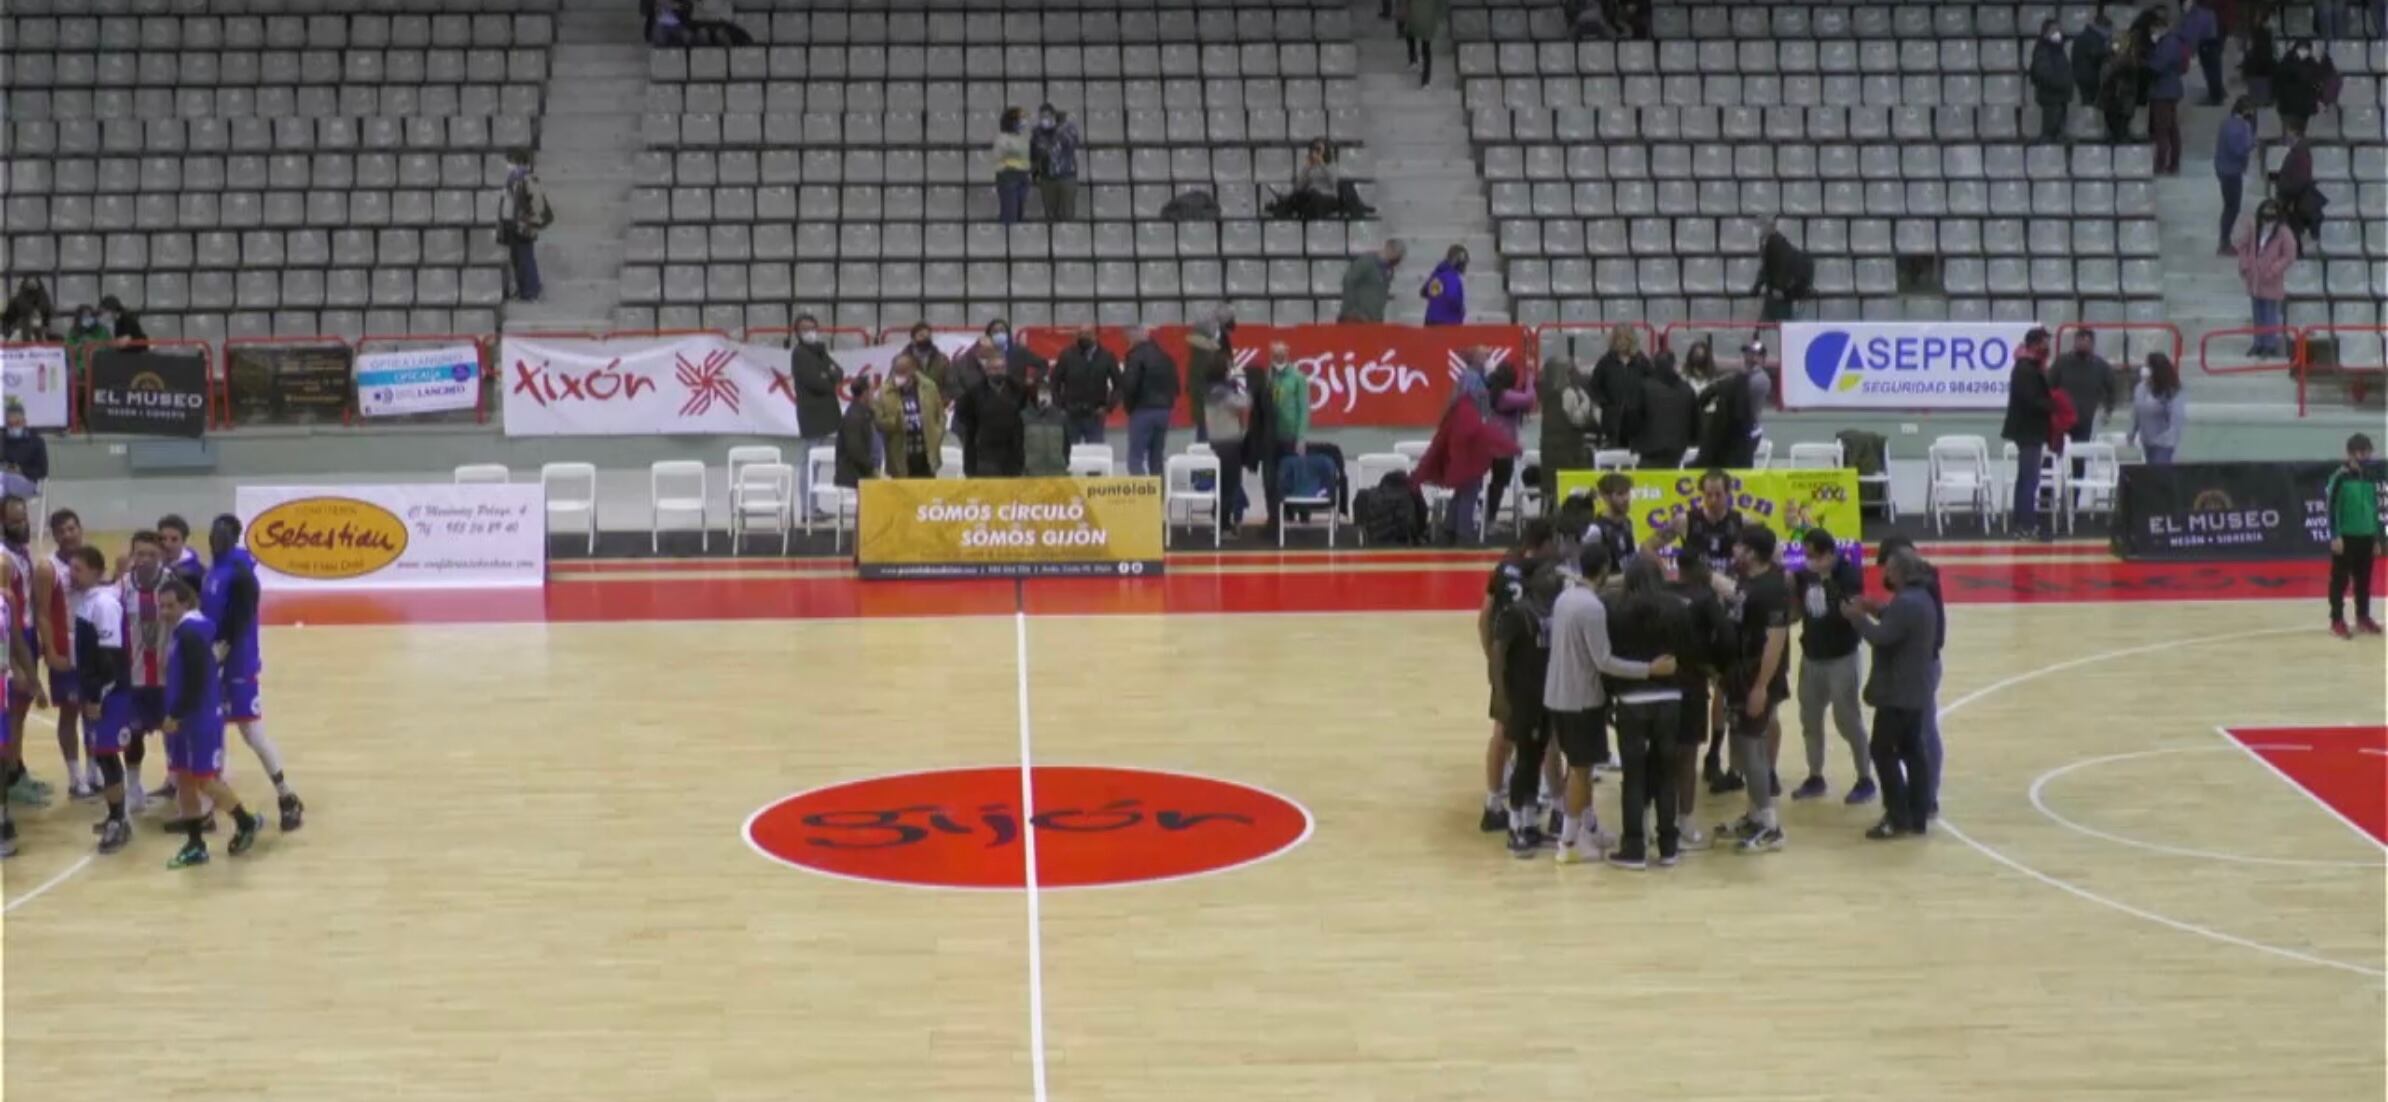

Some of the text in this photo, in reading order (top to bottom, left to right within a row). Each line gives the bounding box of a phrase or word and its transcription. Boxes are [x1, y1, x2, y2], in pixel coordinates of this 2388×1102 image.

[1862, 381, 1946, 394] SEGURIDAD
[94, 389, 203, 409] EL MUSEO
[2149, 509, 2280, 534] EL MUSEO
